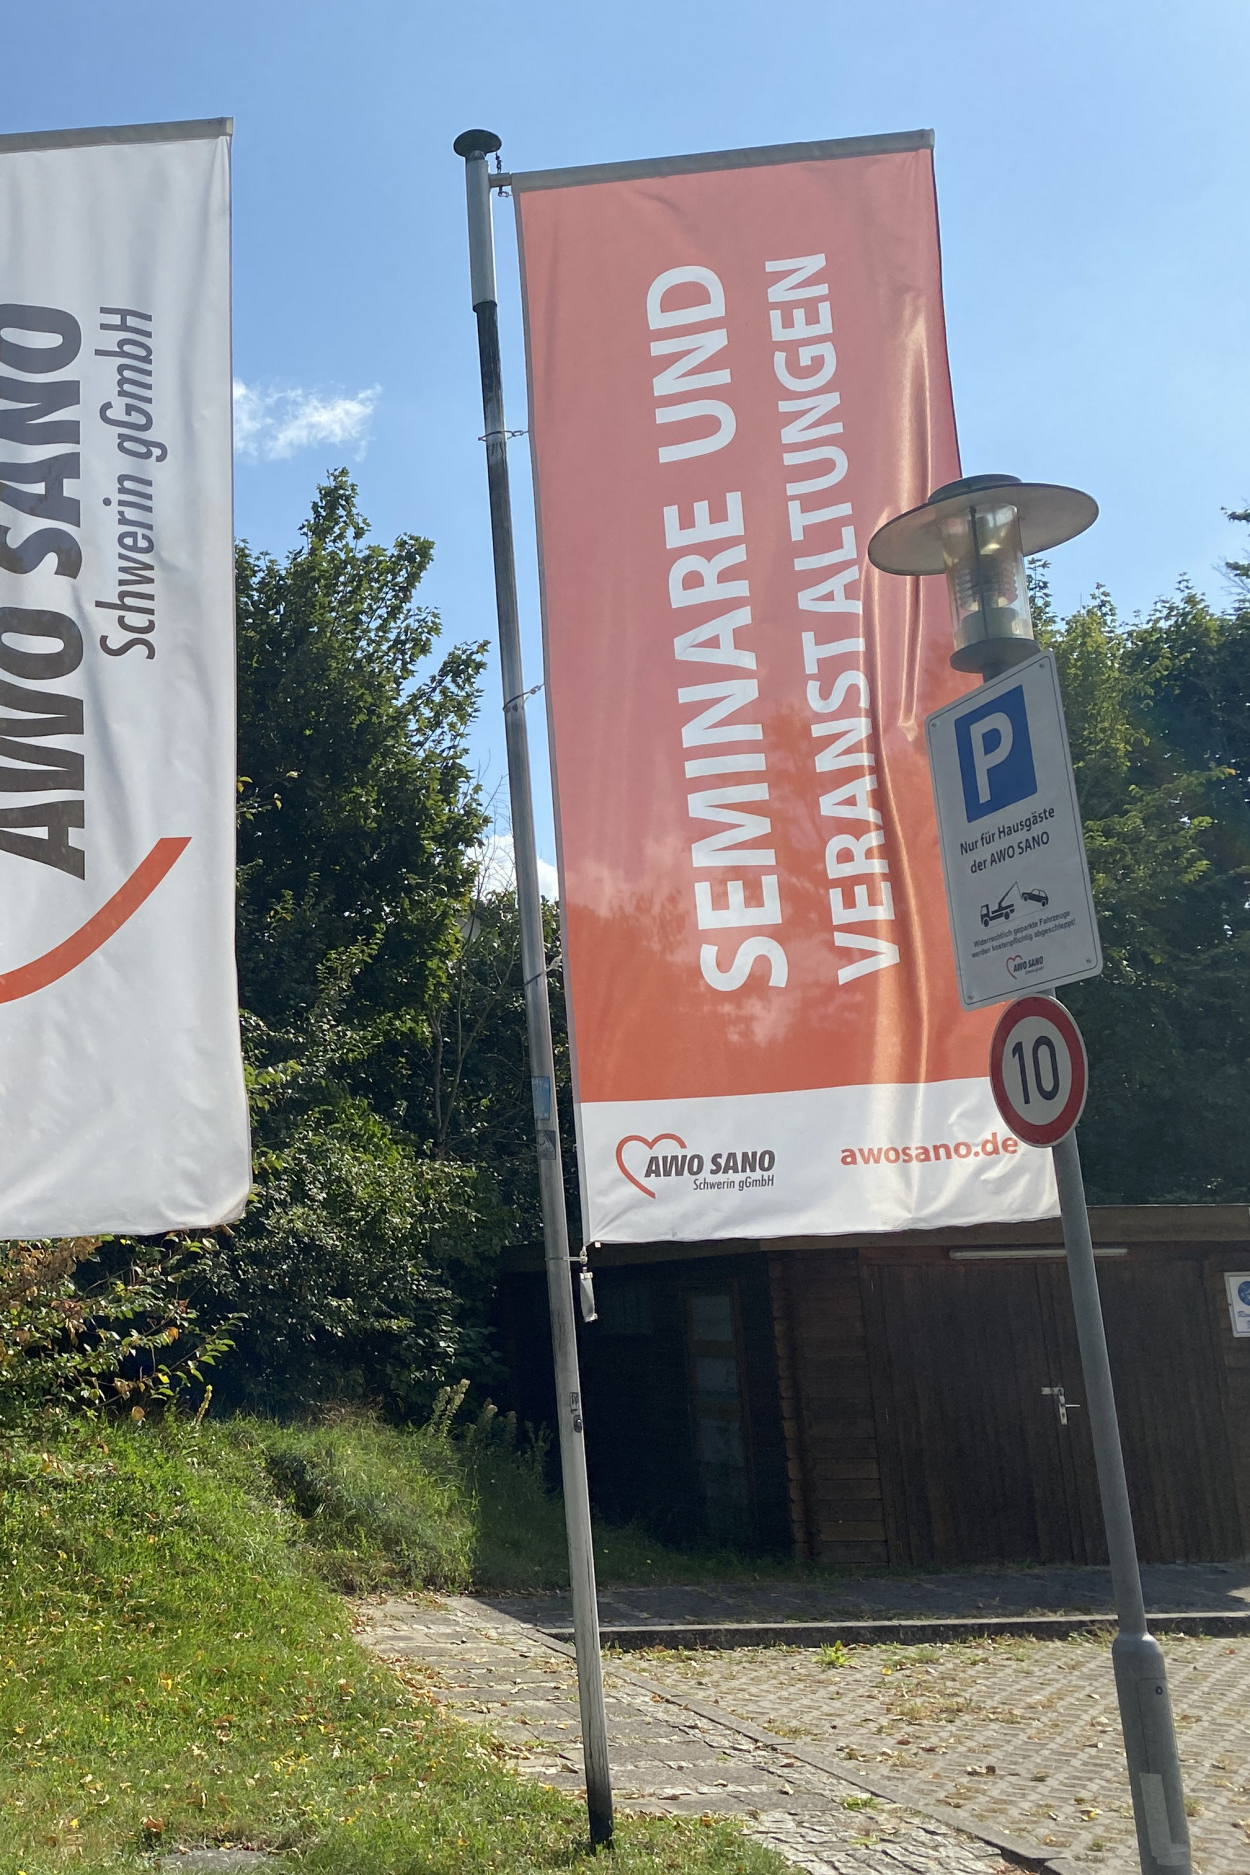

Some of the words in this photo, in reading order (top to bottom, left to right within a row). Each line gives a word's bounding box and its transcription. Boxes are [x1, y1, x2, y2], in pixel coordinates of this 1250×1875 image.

[94, 306, 168, 463] gGmbH
[646, 265, 737, 464] UND
[94, 470, 156, 661] Schwerin
[764, 252, 901, 986] VERANSTALTUNGEN
[662, 490, 789, 992] SEMINARE
[969, 711, 1014, 805] P
[959, 838, 979, 856] Nur
[980, 831, 997, 848] für
[997, 806, 1056, 840] Hausgäste
[970, 858, 988, 874] der
[989, 845, 1016, 868] AWO
[1017, 831, 1050, 855] SANO
[971, 946, 992, 959] werden
[991, 932, 1034, 952] kostenpflichtig
[973, 929, 1013, 948] Widerrechtlich
[1013, 920, 1039, 936] geparkte
[1039, 910, 1071, 926] Fahrzeuge
[1013, 960, 1028, 973] AWO
[1028, 956, 1044, 969] SANO
[1011, 1035, 1060, 1105] 10
[644, 1153, 704, 1179] AWO
[710, 1150, 776, 1175] SANO
[840, 1132, 1019, 1167] awosano.de
[693, 1177, 735, 1191] Schwerin
[738, 1174, 775, 1192] gGmbH
